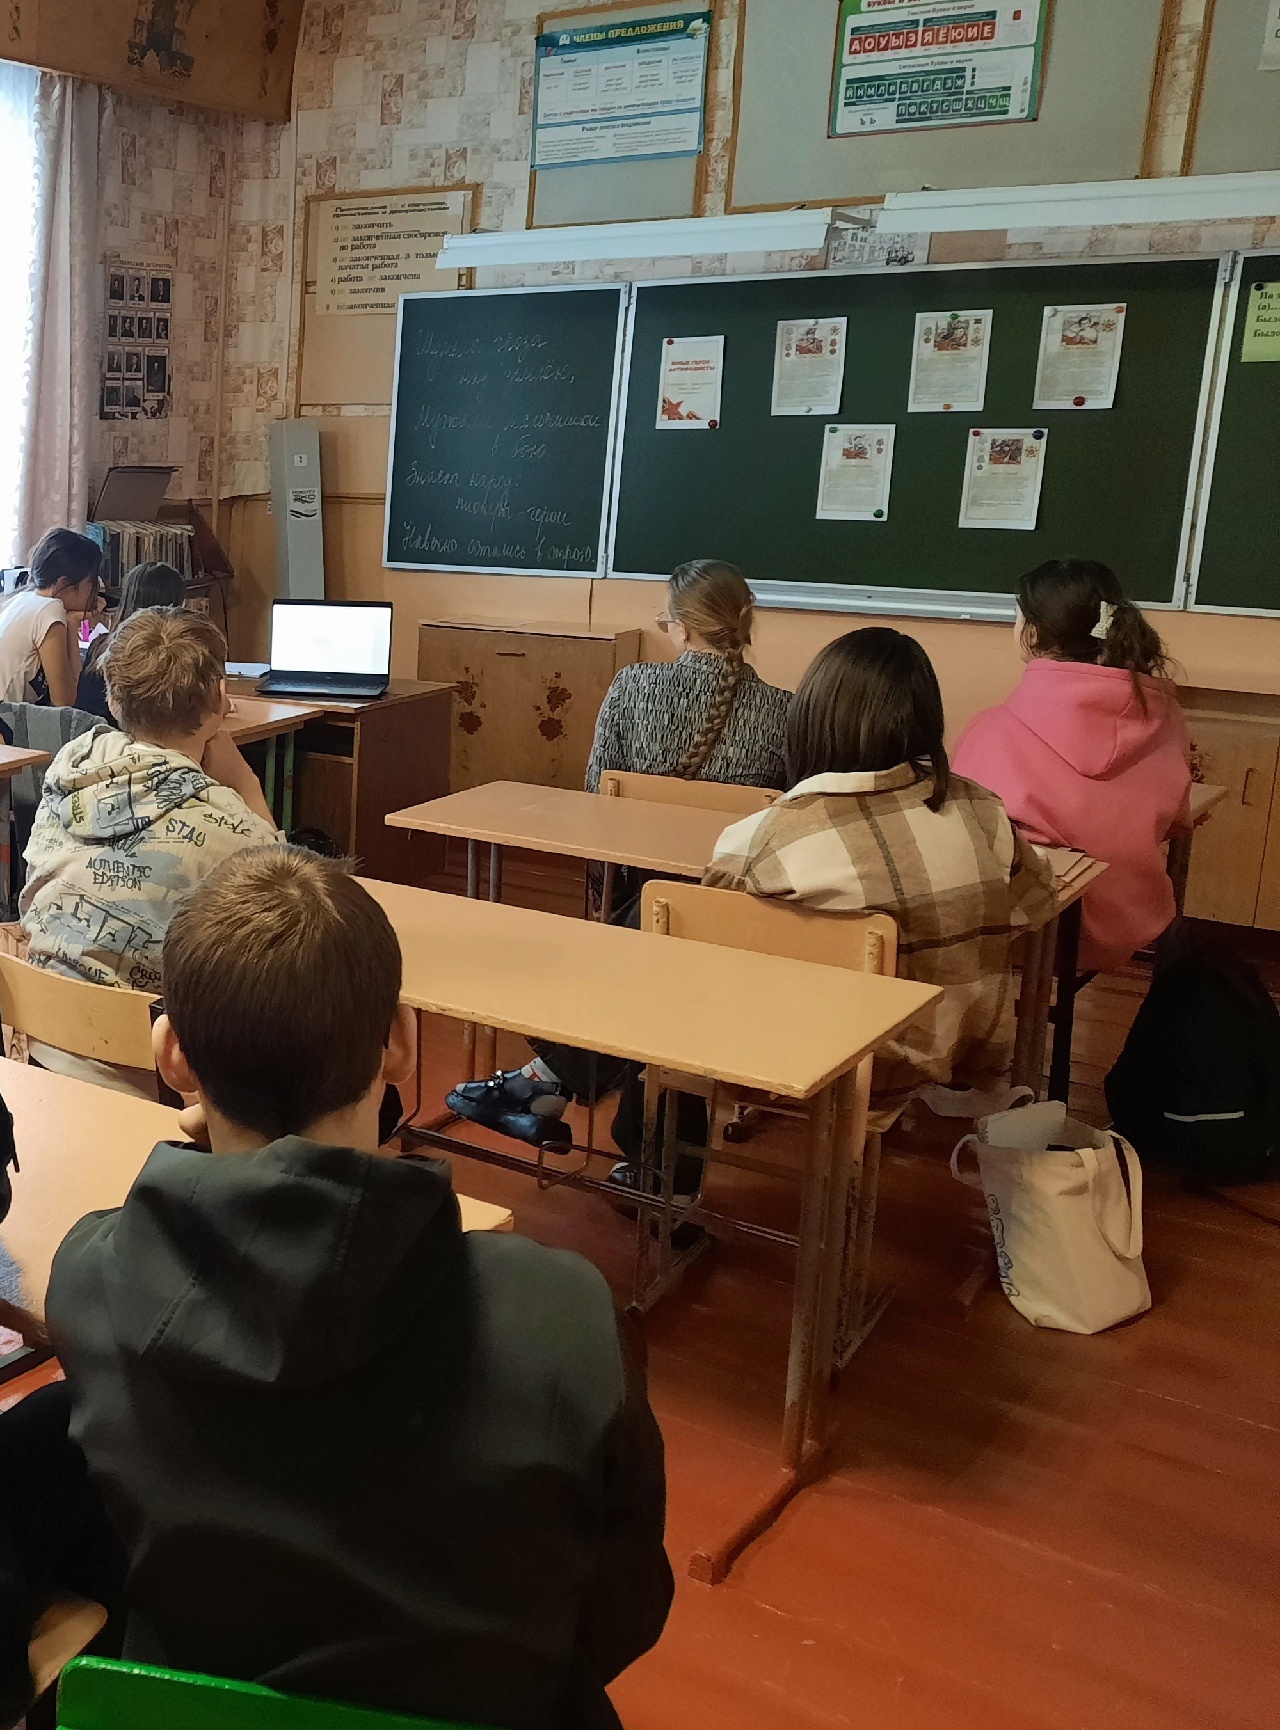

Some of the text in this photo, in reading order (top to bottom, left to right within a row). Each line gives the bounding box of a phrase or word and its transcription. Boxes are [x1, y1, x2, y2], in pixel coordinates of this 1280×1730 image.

[573, 19, 685, 43] ЧЛЕНЫ ПРЕДЛОЖЕНИЯ
[353, 222, 393, 230] закончить
[351, 233, 402, 243] законченная
[350, 242, 377, 253] работа
[338, 261, 399, 272] начатая работа
[337, 274, 364, 286] работа
[378, 273, 421, 281] закончена
[405, 460, 461, 487] Знает
[166, 817, 206, 847] STAY
[86, 857, 152, 879] AUTHENTIC
[93, 871, 142, 892] EDITION
